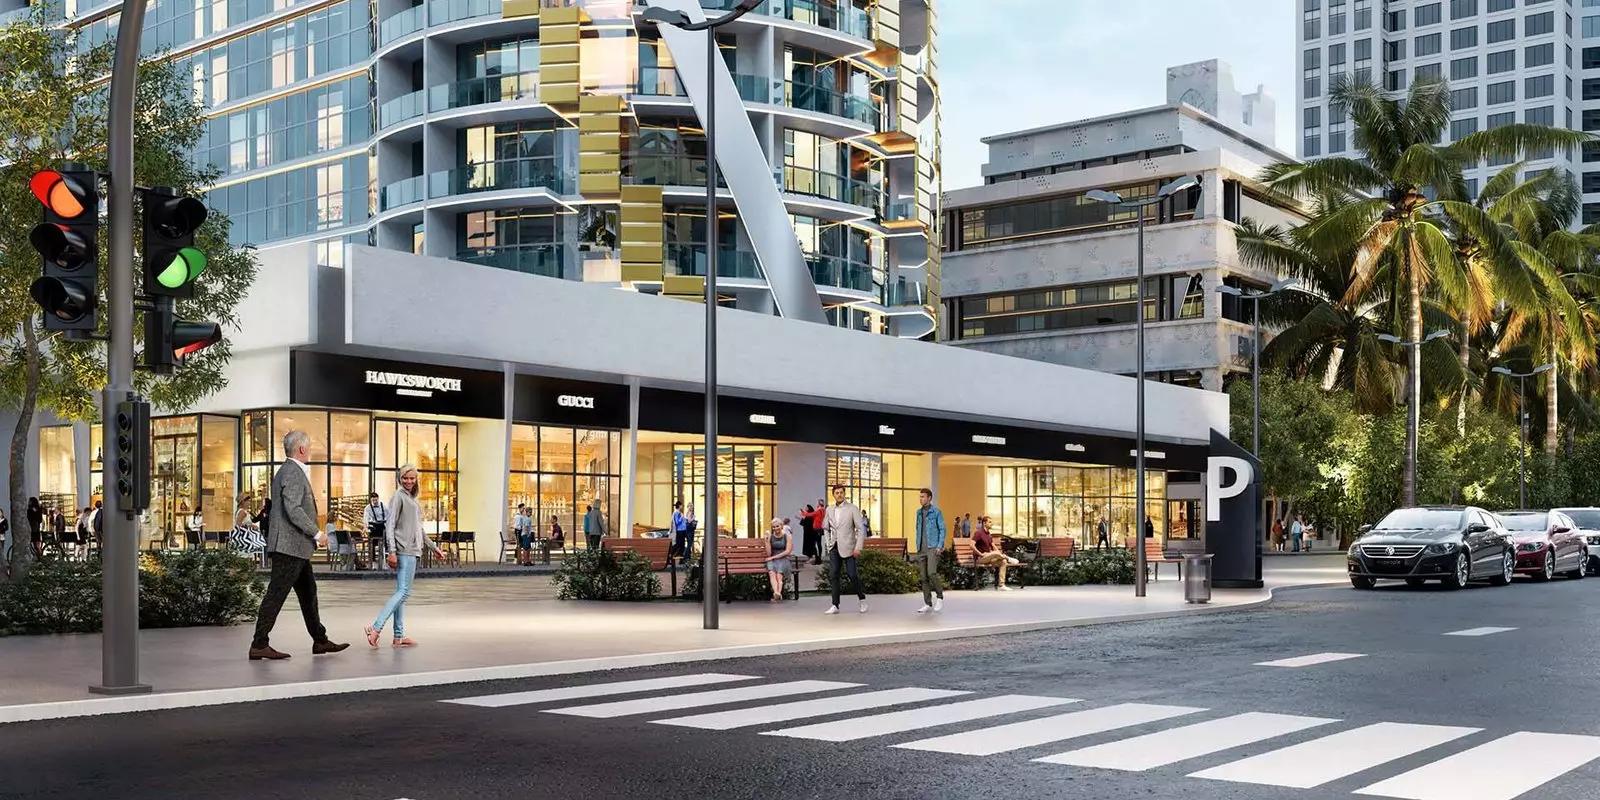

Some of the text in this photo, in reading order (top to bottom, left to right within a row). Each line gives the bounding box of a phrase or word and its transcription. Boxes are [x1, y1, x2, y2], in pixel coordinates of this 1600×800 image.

[366, 371, 461, 391] HAWKSWORTH
[558, 395, 594, 408] GUCCI
[1207, 455, 1254, 521] P
